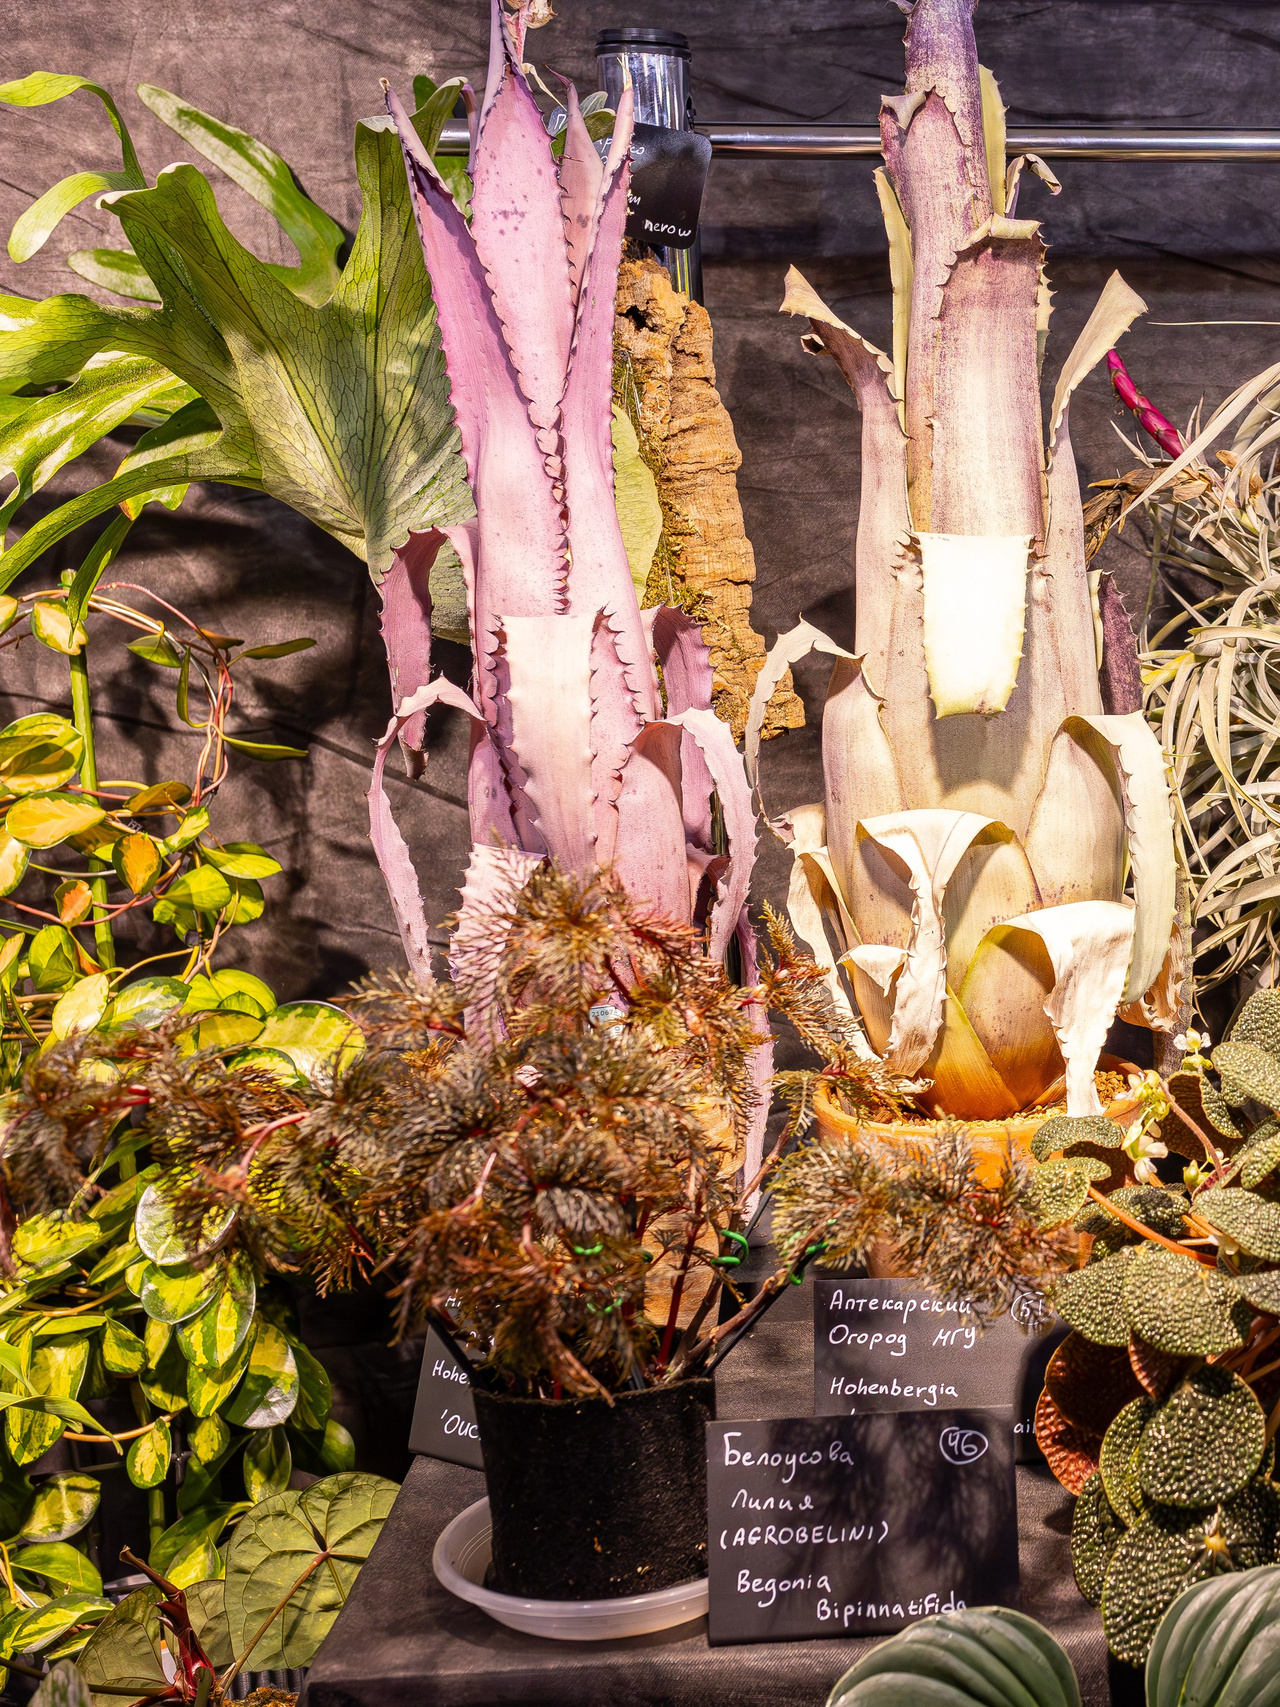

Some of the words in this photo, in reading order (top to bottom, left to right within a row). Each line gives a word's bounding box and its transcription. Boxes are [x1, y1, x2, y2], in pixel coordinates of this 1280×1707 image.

[829, 1288, 972, 1325] Аптекарский
[828, 1324, 908, 1357] Огород
[829, 1376, 959, 1406] Hohenbergia
[722, 1432, 854, 1484] Белоусова
[731, 1488, 814, 1512] Лилия
[719, 1520, 890, 1550] (AGROBELINI)
[737, 1569, 832, 1609] Begonia
